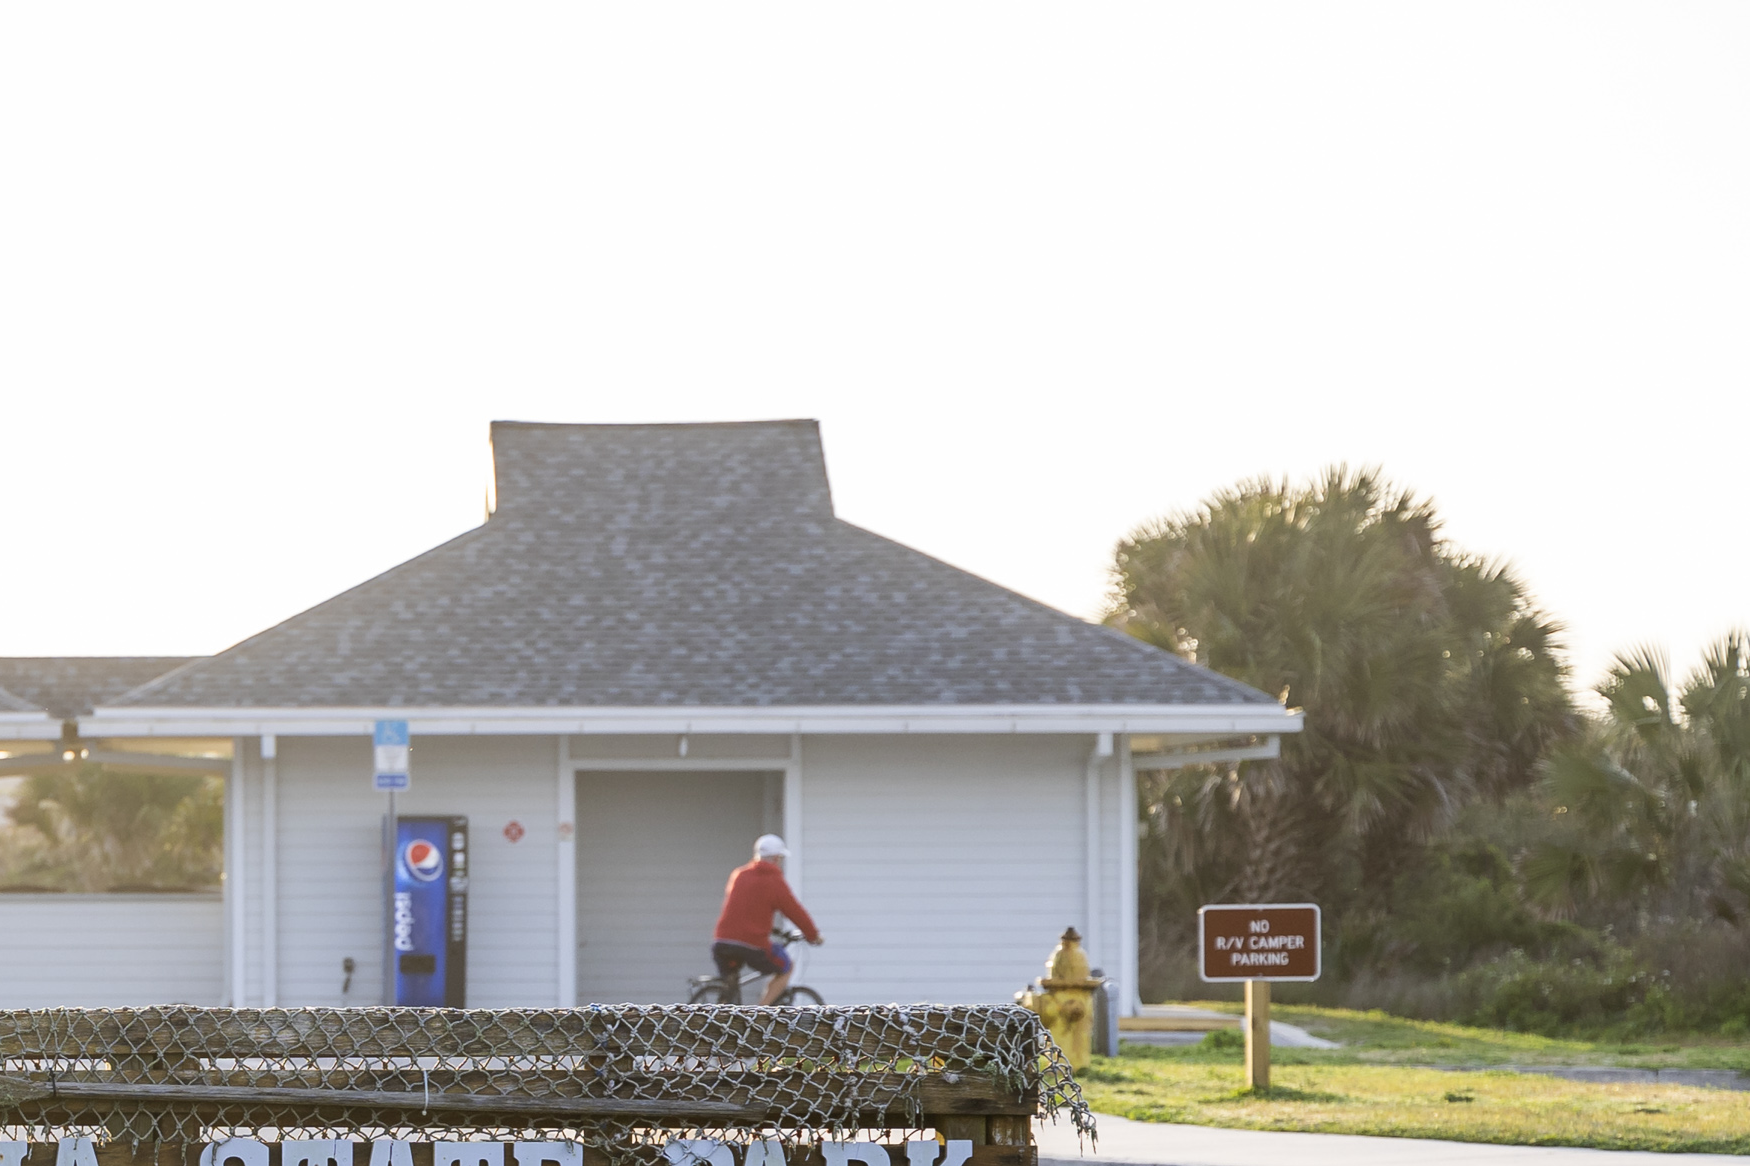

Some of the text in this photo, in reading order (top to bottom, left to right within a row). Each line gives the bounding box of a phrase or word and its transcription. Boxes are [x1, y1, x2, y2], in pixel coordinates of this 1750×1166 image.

[394, 891, 414, 951] pepsi
[1249, 919, 1270, 934] NO
[1215, 935, 1305, 950] R/V CAMPER
[1231, 952, 1289, 966] PARKING
